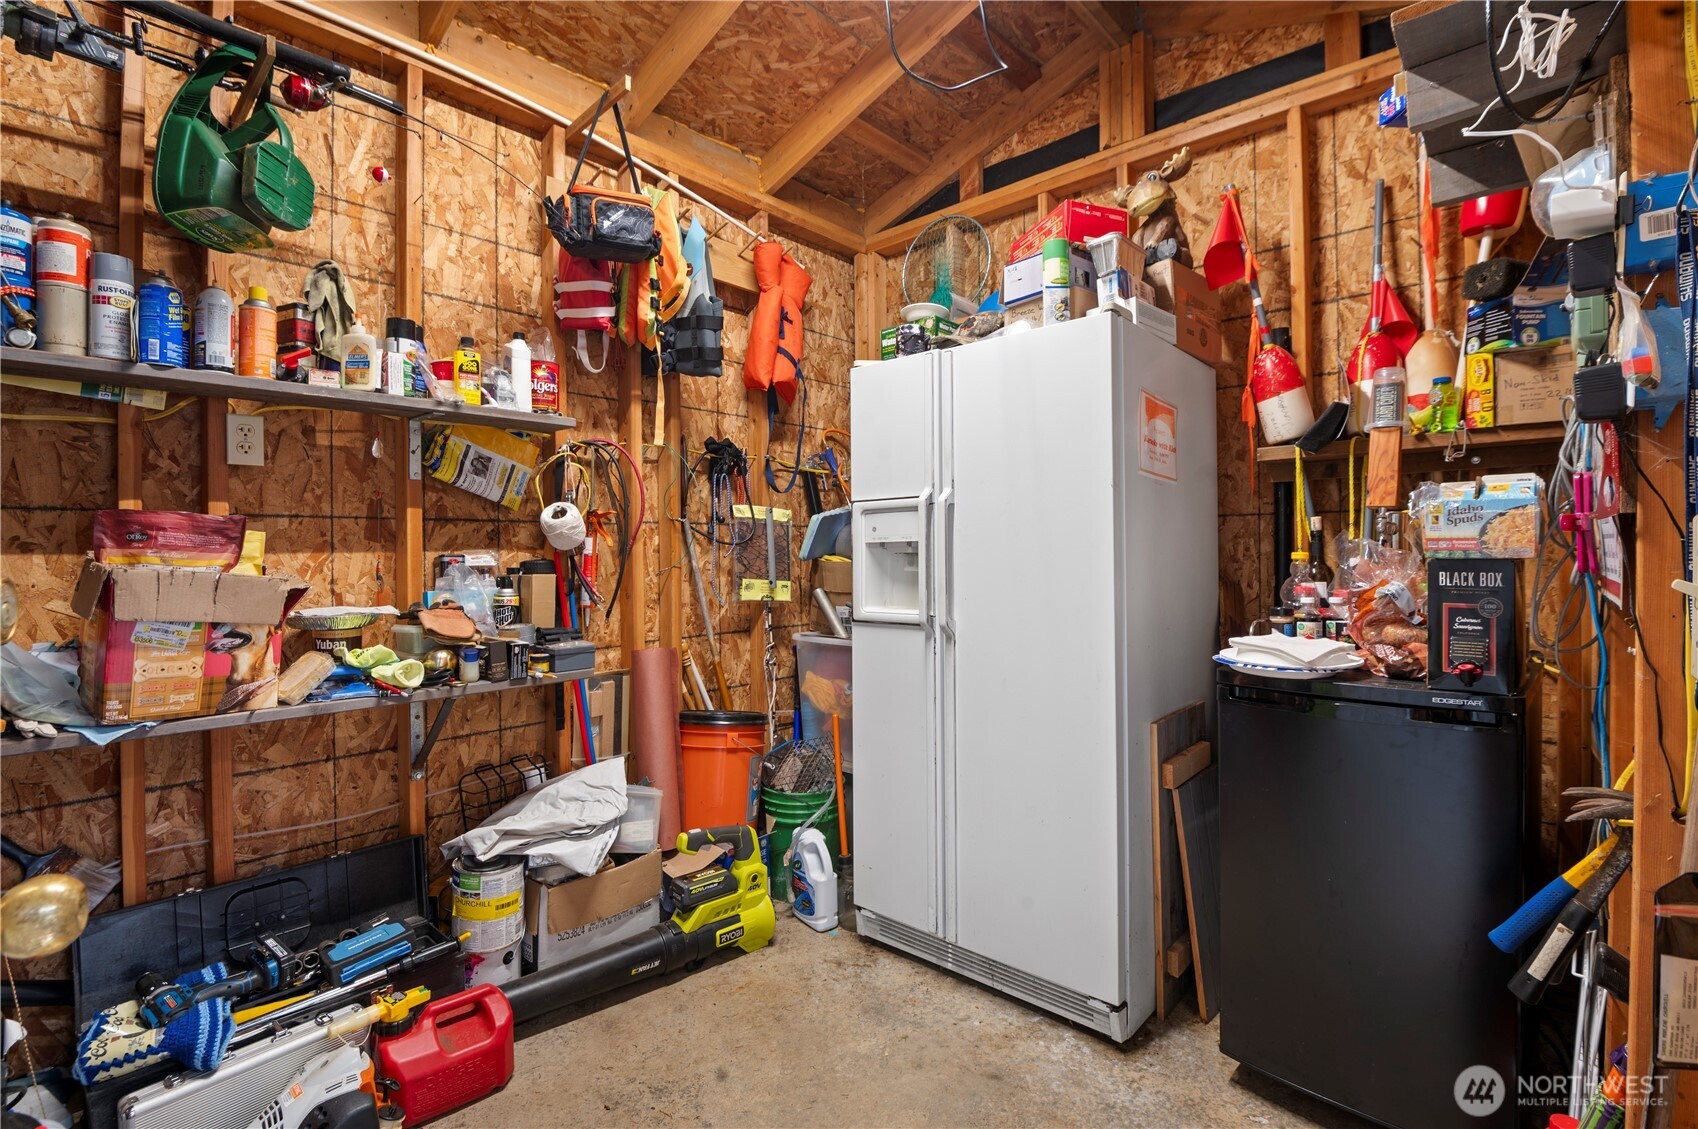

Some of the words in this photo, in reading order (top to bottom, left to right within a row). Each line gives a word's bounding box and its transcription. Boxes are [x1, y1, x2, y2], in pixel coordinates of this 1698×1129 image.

[1679, 252, 1694, 302] SHIMANO
[1516, 314, 1546, 322] FOUNTAIN
[1522, 320, 1541, 328] PUMP
[1503, 374, 1560, 390] Non-Skid
[1446, 504, 1484, 517] Idaho
[1446, 513, 1484, 527] Spuds
[1439, 571, 1475, 587] BLACK
[1479, 572, 1504, 588] BOX
[496, 606, 512, 617] HOT
[495, 612, 513, 627] SHOT
[315, 639, 347, 650] Yuban
[1432, 697, 1482, 706] EDGESTAR
[747, 882, 762, 892] 40V
[455, 896, 492, 908] CHURCHILL
[720, 928, 744, 944] RYOBI
[424, 1057, 484, 1089] DANGER
